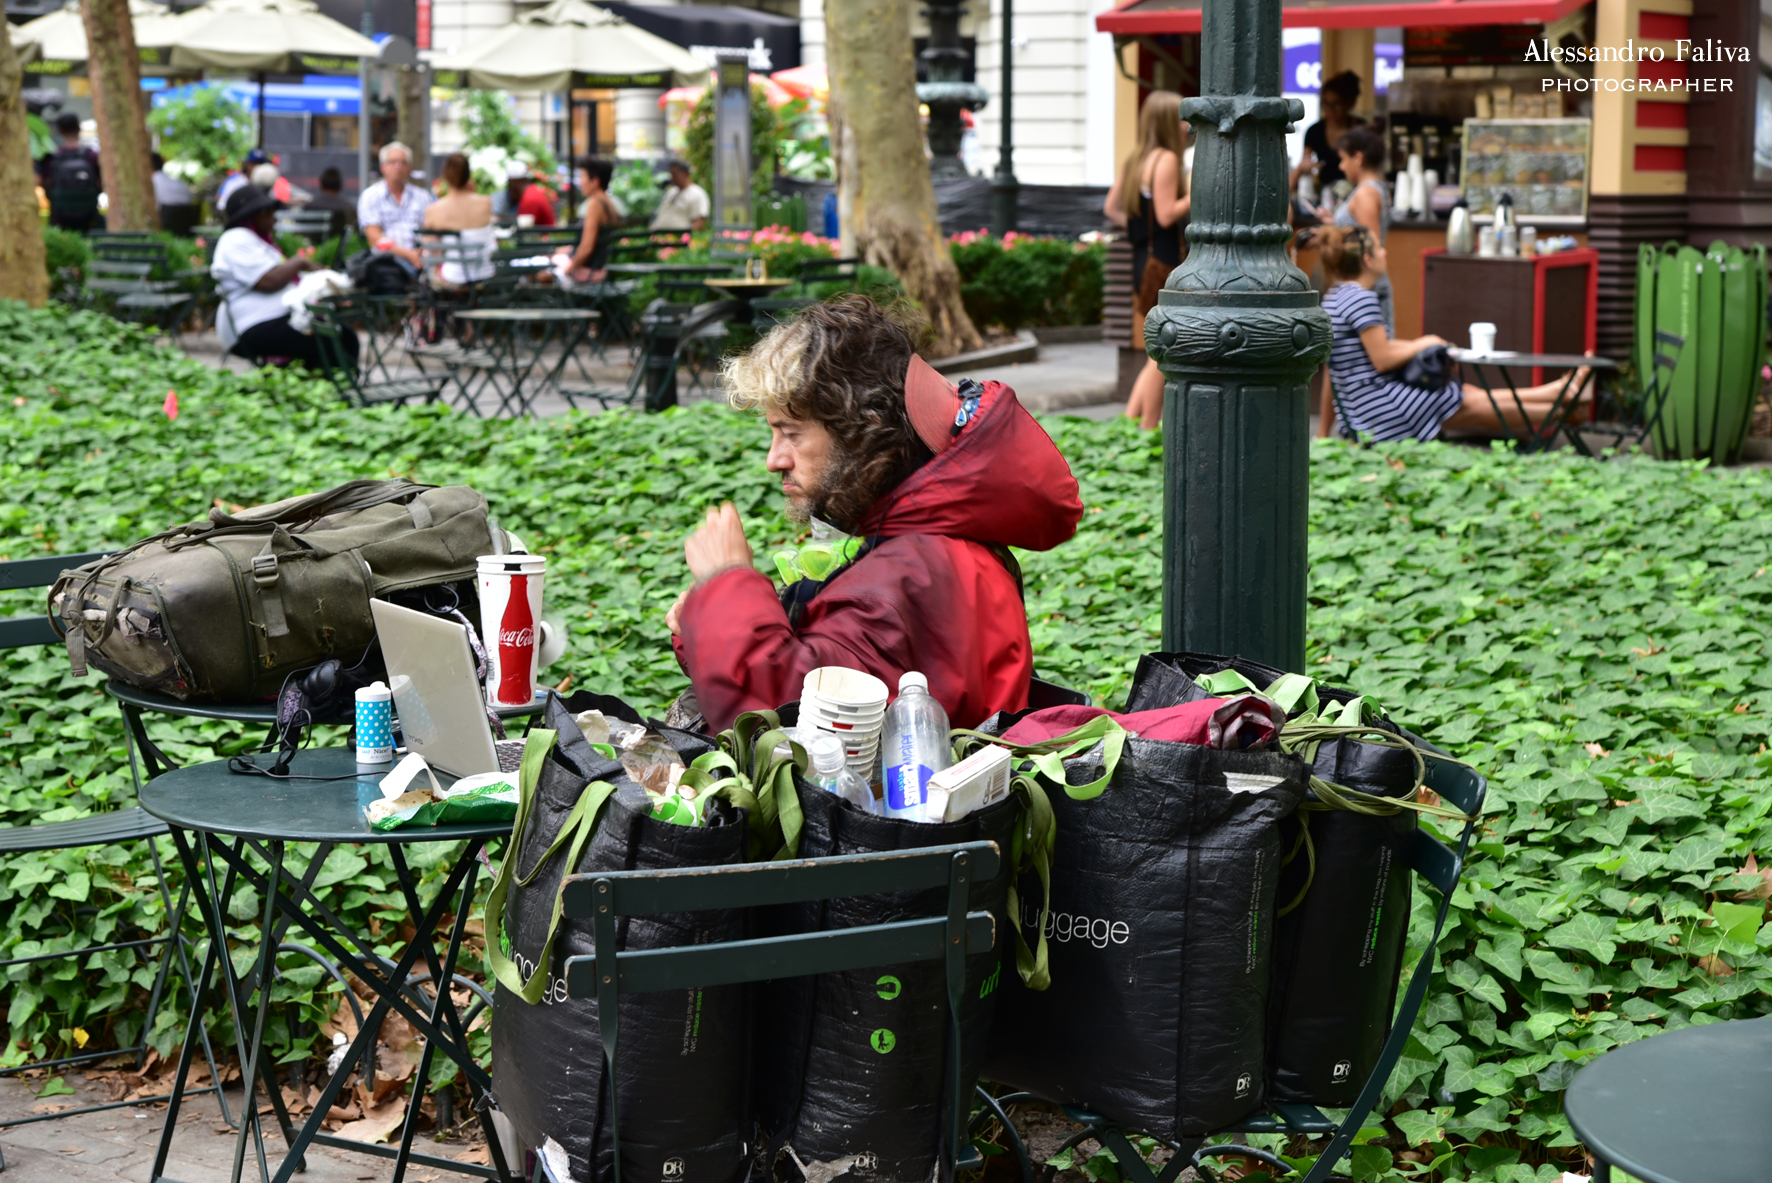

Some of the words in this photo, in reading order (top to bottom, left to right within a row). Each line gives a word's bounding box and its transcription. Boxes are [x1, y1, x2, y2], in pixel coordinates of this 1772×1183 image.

[1384, 849, 1392, 871] pounds
[1020, 896, 1130, 949] luggage
[1374, 907, 1382, 926] waste
[1370, 927, 1379, 950] reduce
[1359, 959, 1367, 967] By
[1367, 950, 1375, 964] NYC
[693, 1012, 701, 1037] reduce
[690, 1037, 698, 1052] NYC
[1332, 1062, 1351, 1077] DR
[1236, 1075, 1251, 1091] DR
[662, 1160, 685, 1176] DR
